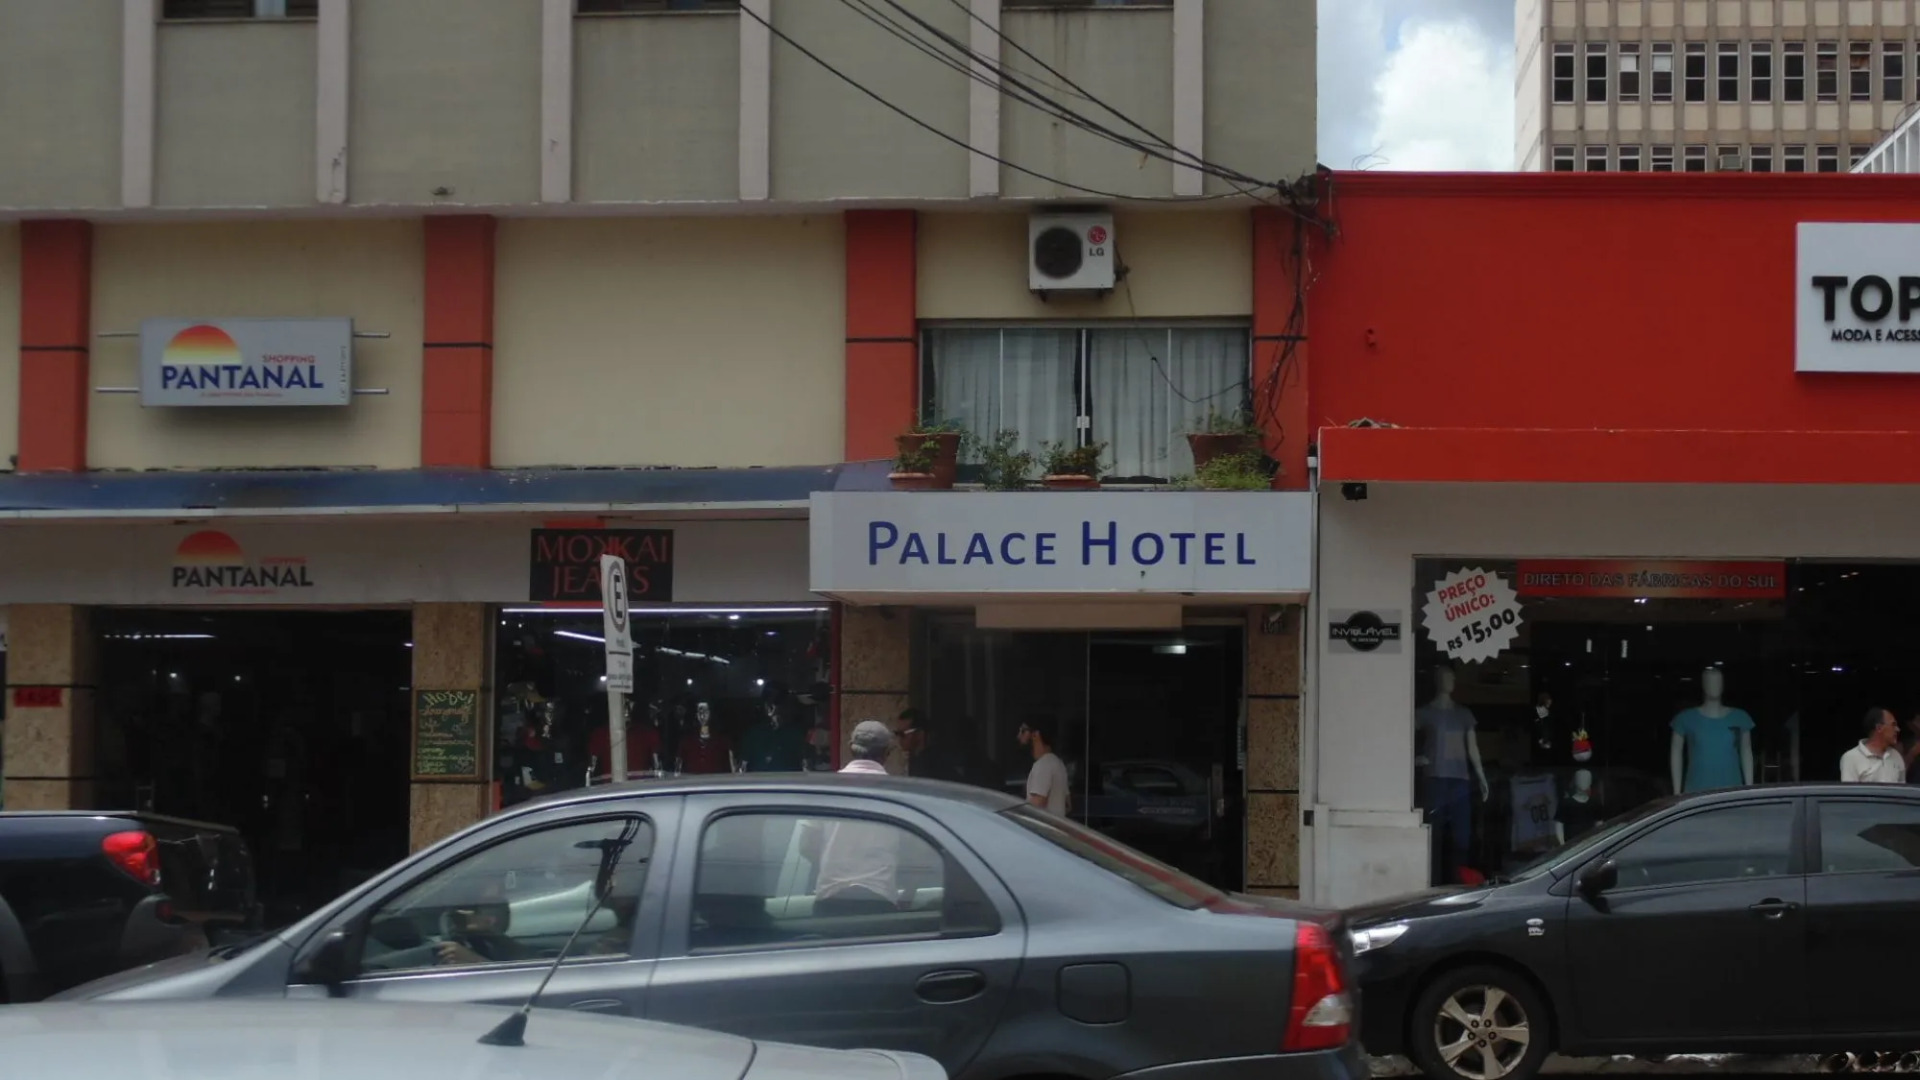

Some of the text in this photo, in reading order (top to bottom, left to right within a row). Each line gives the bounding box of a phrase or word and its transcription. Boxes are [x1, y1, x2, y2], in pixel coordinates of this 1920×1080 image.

[1088, 247, 1105, 257] LG
[1811, 275, 1920, 322] TOP
[1831, 328, 1872, 341] MODA
[1875, 328, 1883, 341] E
[161, 365, 324, 390] PANTANAL
[868, 521, 1257, 566] PALACE HOTEL
[172, 566, 314, 588] PANTANAL
[552, 566, 650, 598] JEAS
[1437, 574, 1487, 603] PREÇO
[1523, 570, 1778, 588] DIRETO DAS FÁBRICAS DO SUL
[1444, 594, 1496, 622] ÚNICO:
[1462, 608, 1516, 644] 15,00
